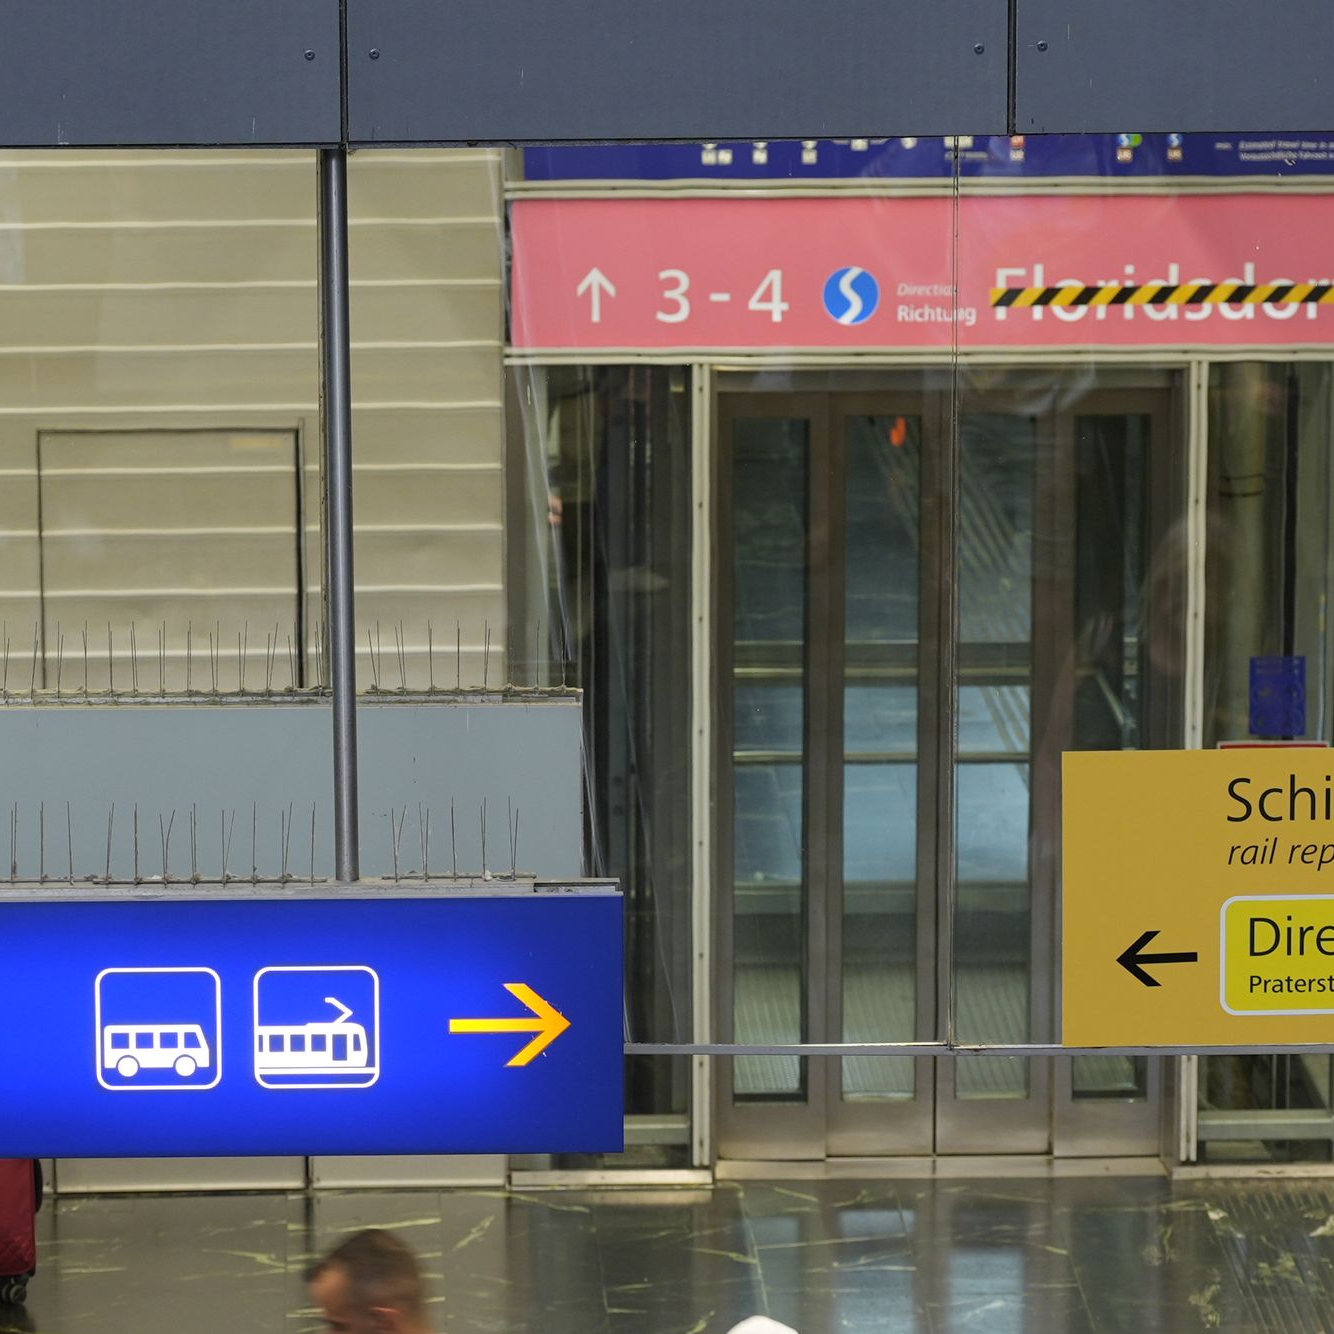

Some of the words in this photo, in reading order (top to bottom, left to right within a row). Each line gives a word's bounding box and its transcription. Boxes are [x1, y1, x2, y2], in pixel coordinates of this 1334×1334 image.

[657, 270, 689, 322] 3
[749, 270, 788, 322] 4
[1228, 837, 1278, 866] rail
